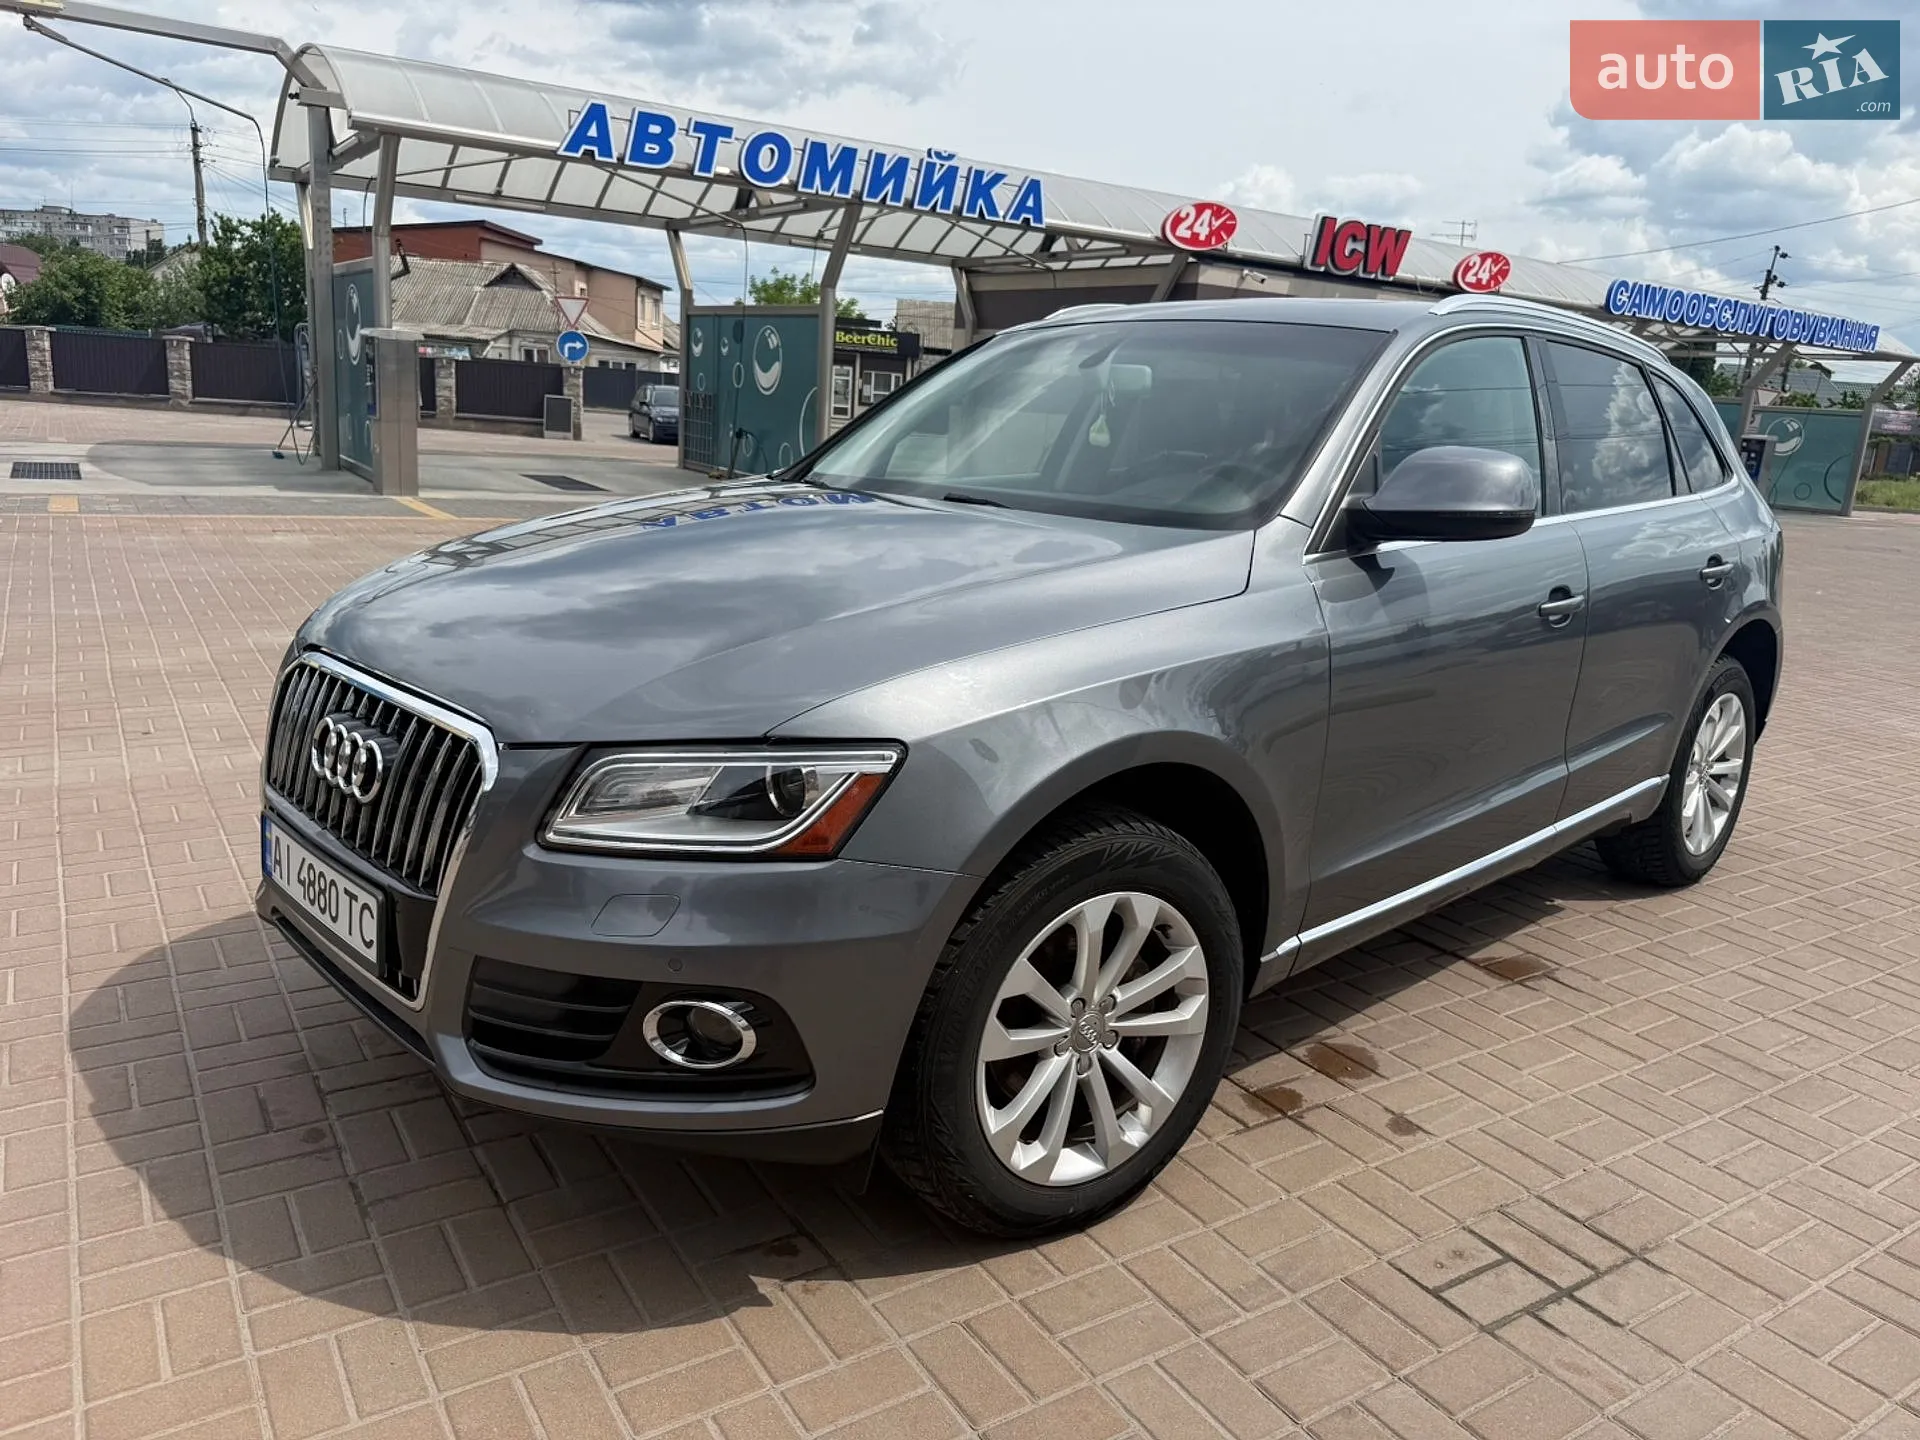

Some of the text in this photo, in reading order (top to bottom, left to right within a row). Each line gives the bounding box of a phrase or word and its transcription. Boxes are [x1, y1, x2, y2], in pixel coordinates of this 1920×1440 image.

[558, 100, 1046, 228] АВТОМИЙКА
[1176, 205, 1211, 241] 24
[1308, 214, 1412, 279] ICW
[1466, 256, 1491, 284] 24
[835, 331, 898, 347] BeerChic
[1606, 279, 1880, 352] САМООБСЛУГОВУВАННЯ
[297, 857, 340, 924] 4880
